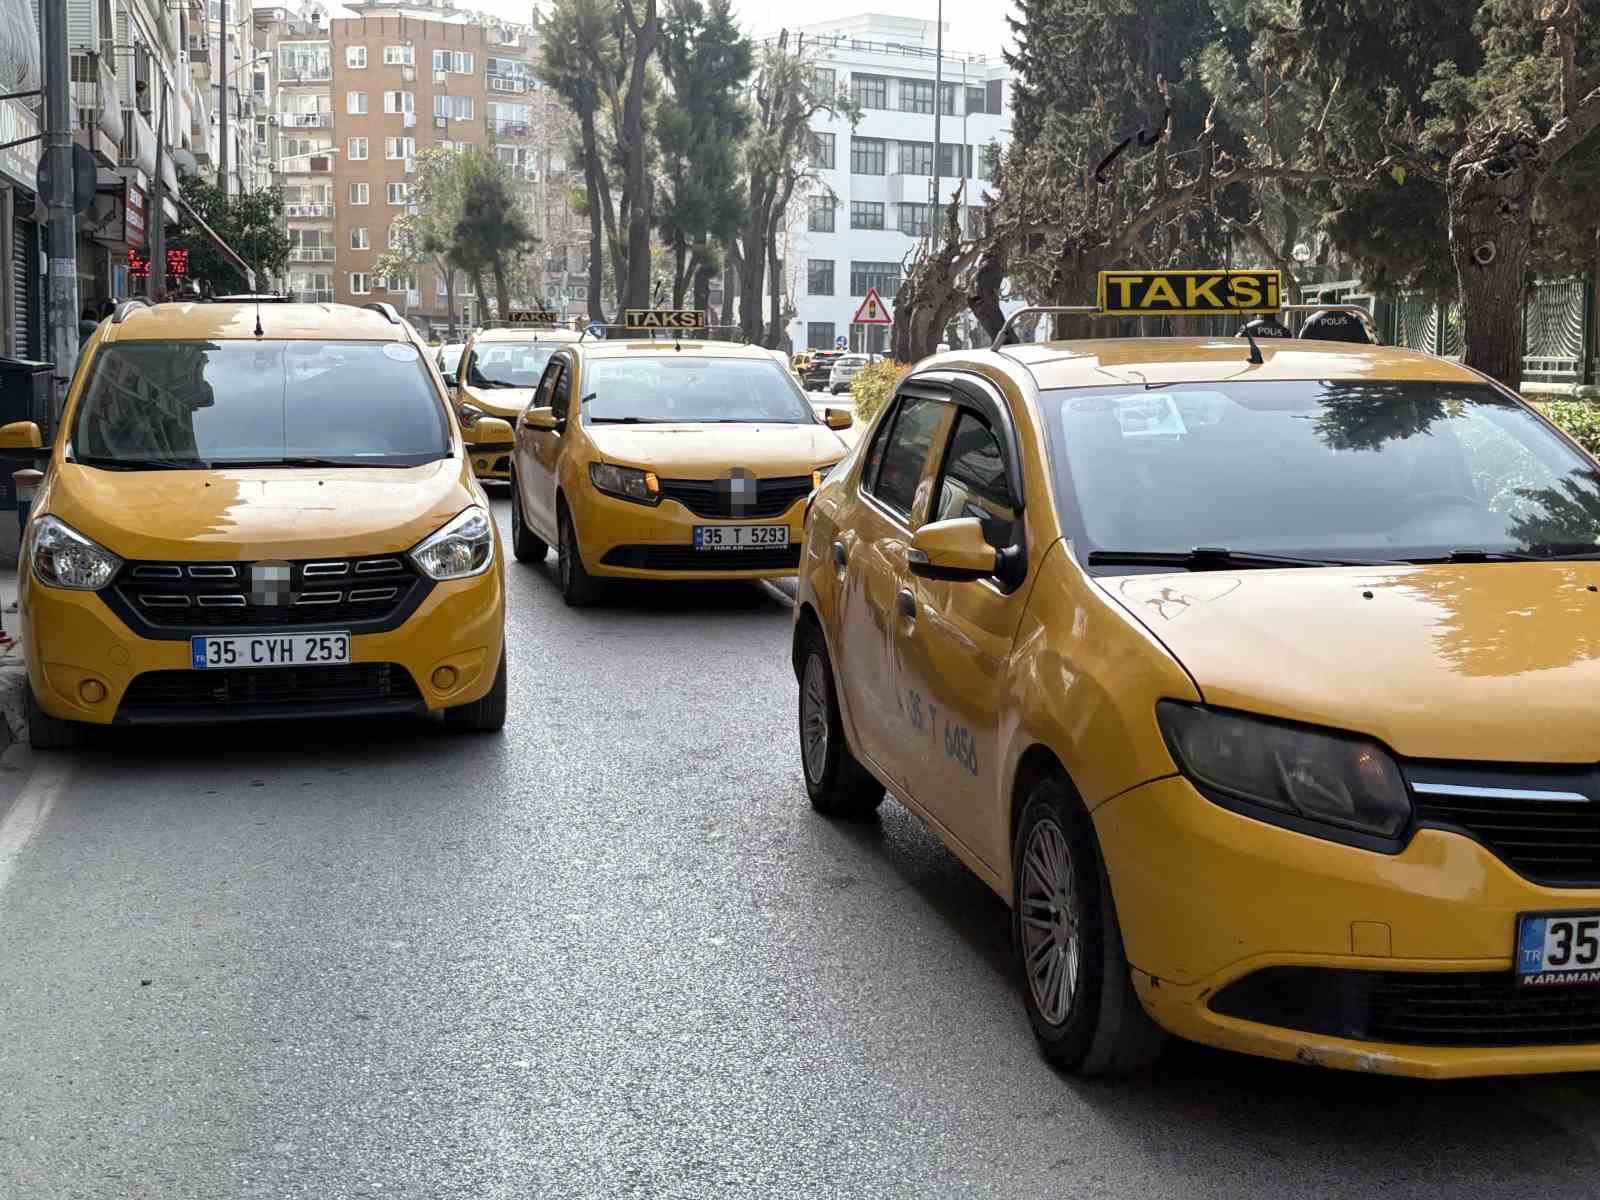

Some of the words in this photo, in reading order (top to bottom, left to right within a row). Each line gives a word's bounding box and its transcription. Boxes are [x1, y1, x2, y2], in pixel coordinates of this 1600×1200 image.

[704, 528, 722, 544] 35
[733, 528, 742, 544] T
[751, 527, 786, 543] 5293
[208, 640, 237, 664] 35
[250, 638, 294, 663] CYH
[305, 637, 347, 661] 253
[1523, 950, 1541, 963] TR
[1548, 920, 1600, 966] 35
